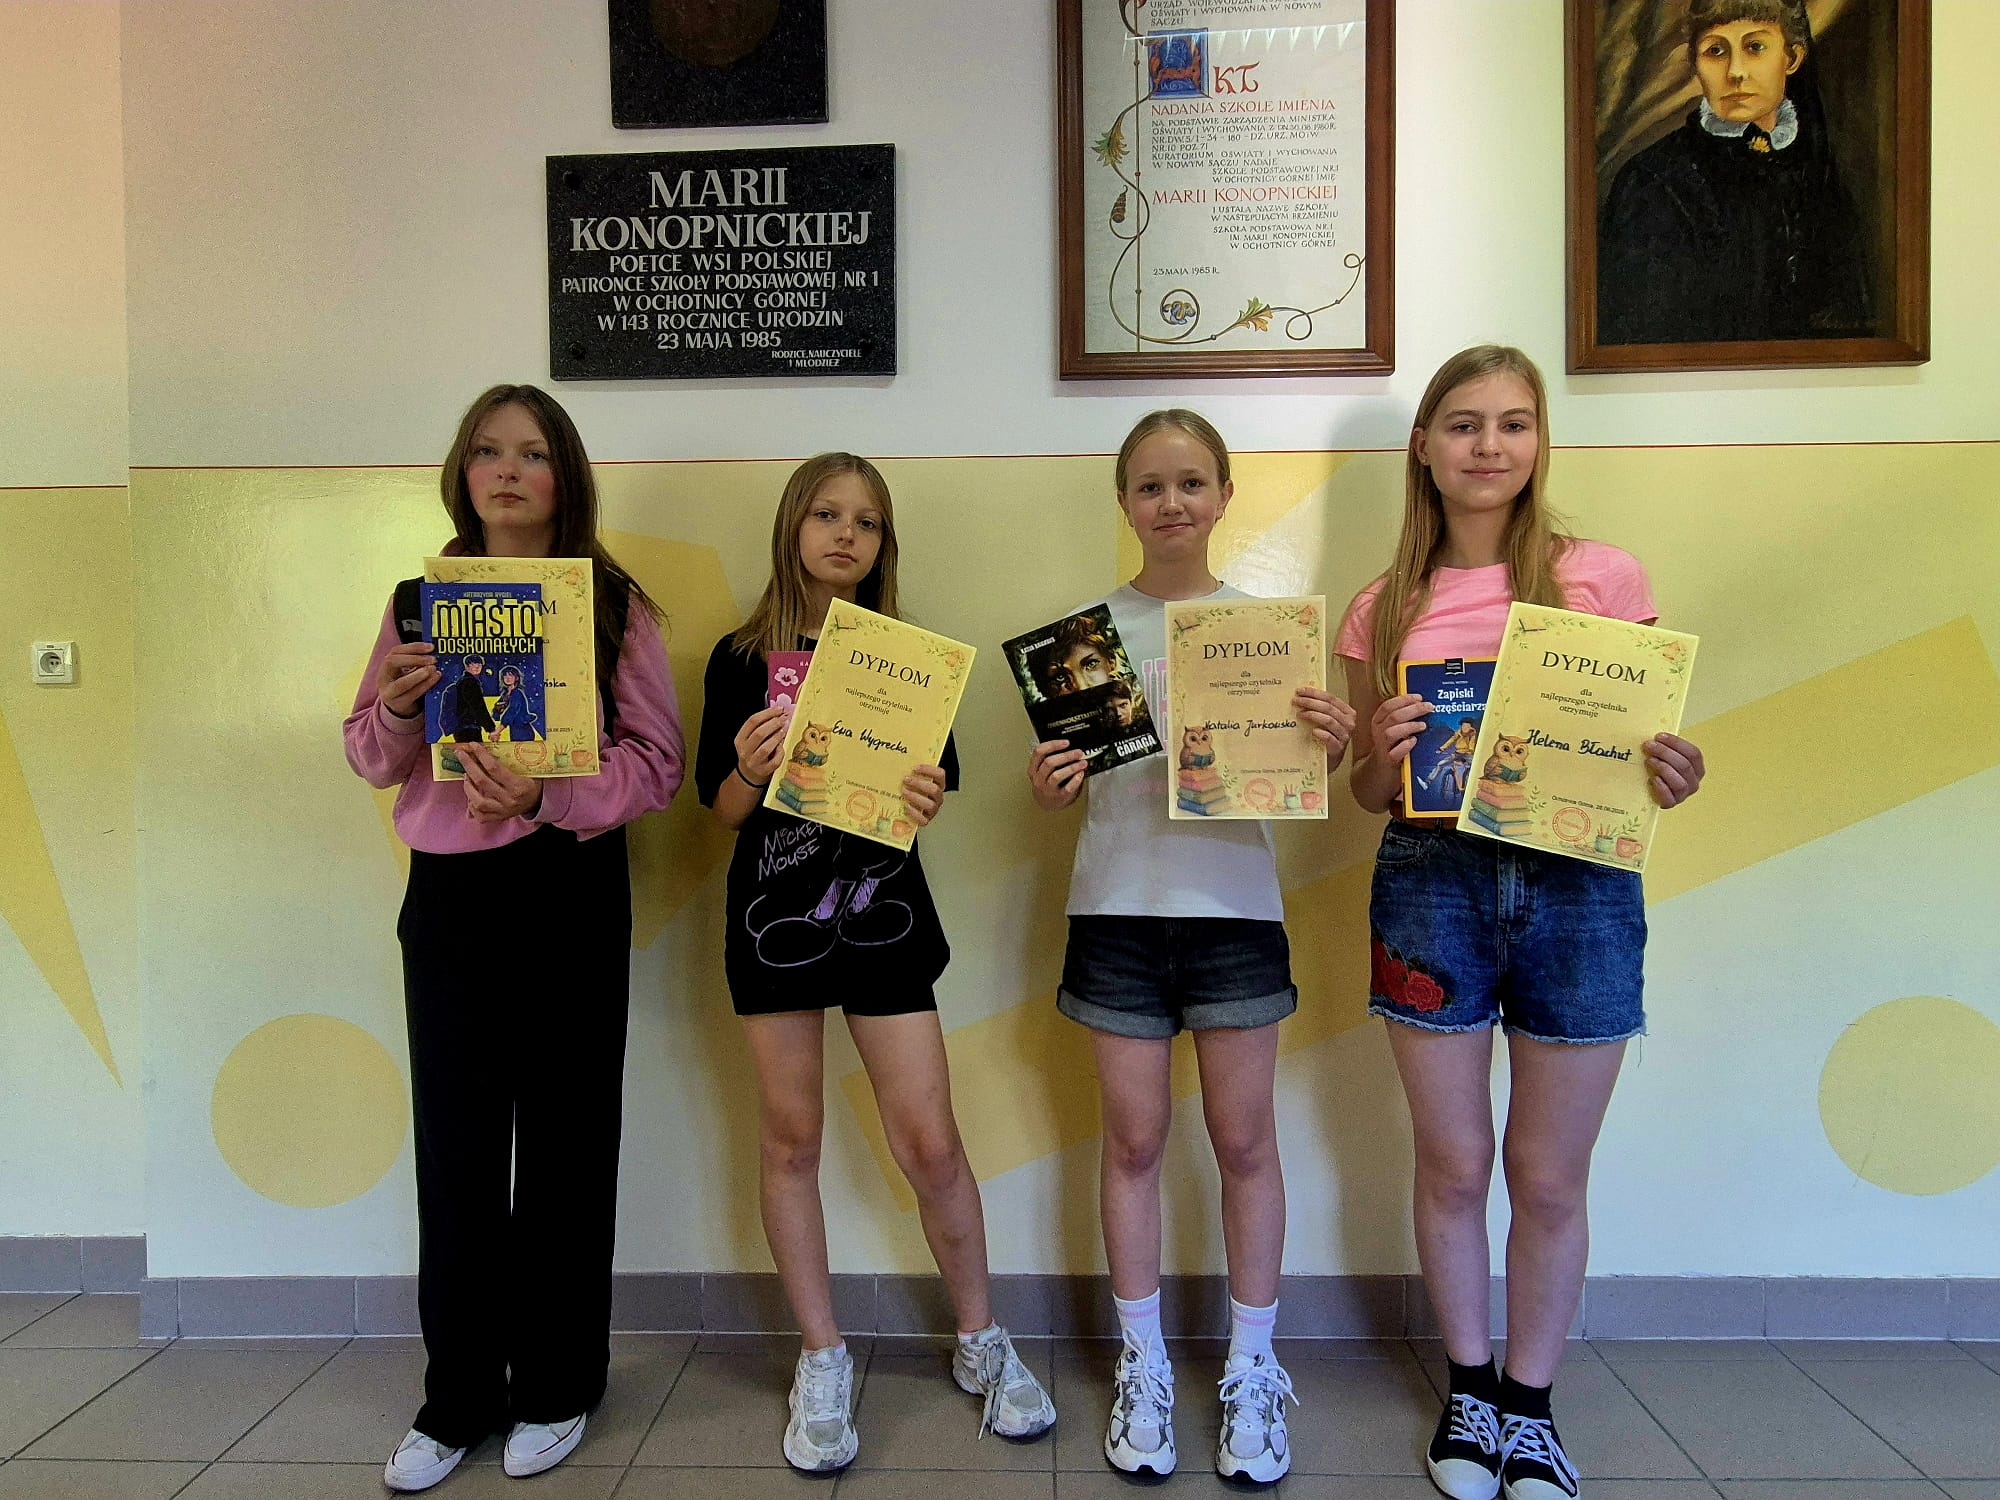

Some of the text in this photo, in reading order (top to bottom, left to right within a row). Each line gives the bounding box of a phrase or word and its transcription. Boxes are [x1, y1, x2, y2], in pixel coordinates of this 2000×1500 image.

[1200, 5, 1266, 15] WYCHOWANIA
[1285, 2, 1321, 10] NOWYM
[1151, 99, 1335, 116] NADANIA SZKOLE IMIENIA
[1152, 119, 1165, 127] NA
[1169, 117, 1219, 126] PODSTAWIE
[1289, 114, 1336, 122] MINISTRA
[1152, 126, 1194, 135] OŚWIATY
[1196, 126, 1199, 134] I
[1202, 124, 1266, 133] WYCHOWANIA
[1152, 151, 1214, 160] KURATORIUM
[1220, 149, 1264, 158] OŚWIATY
[1276, 147, 1338, 156] WYCHOWANIA
[1152, 161, 1162, 169] W
[1167, 160, 1204, 169] NOWYM
[1243, 158, 1277, 167] NADAJE
[1212, 167, 1247, 175] SZKOLE
[1251, 165, 1319, 174] PODSTAWOWEJ
[1225, 174, 1276, 183] OCHOTNICY
[1278, 173, 1313, 182] GÓRNEJ
[649, 168, 788, 208] MARII
[1152, 185, 1337, 205] MARII KONOPNICKIEJ
[1292, 211, 1339, 220] BRZMIENIU
[569, 212, 872, 250] KONOPNICKIEJ
[1243, 234, 1268, 242] MARII
[1272, 231, 1334, 240] KONOPNICKIEJ
[1249, 223, 1312, 233] PODSTAWOWA
[1242, 240, 1297, 250] OCHOTNICY
[1301, 239, 1336, 248] GÓRNEJ
[610, 251, 832, 273] POETCE WSI POLSKIEJ
[562, 270, 879, 293] PATRONCE SZKOŁY PODSTAWOWEJ NR 1
[613, 289, 827, 312] W OCHOTNICY GÓRNEJ
[598, 310, 844, 331] W 143 ROCZNICE URODZIN
[657, 331, 781, 350] 23 MAJA 1985
[437, 604, 536, 638] MIASTO
[438, 637, 536, 654] DOSKONAŁYCH
[1203, 641, 1290, 660] DYPLOM
[848, 649, 932, 688] DYPLOM
[1541, 650, 1647, 685] DYPLOM
[845, 687, 913, 713] najlepszego czytelnika
[877, 687, 887, 696] dla
[1437, 687, 1474, 702] Zapiski
[1580, 689, 1593, 697] dla
[860, 701, 890, 715] otrzymuje
[1540, 692, 1628, 713] najlepszego czytelnika
[1559, 705, 1599, 719] otrzymuje
[832, 720, 853, 738] Ewa
[1203, 719, 1240, 730] Natalia
[1116, 734, 1157, 758] CARAGA
[1527, 729, 1570, 752] Helena
